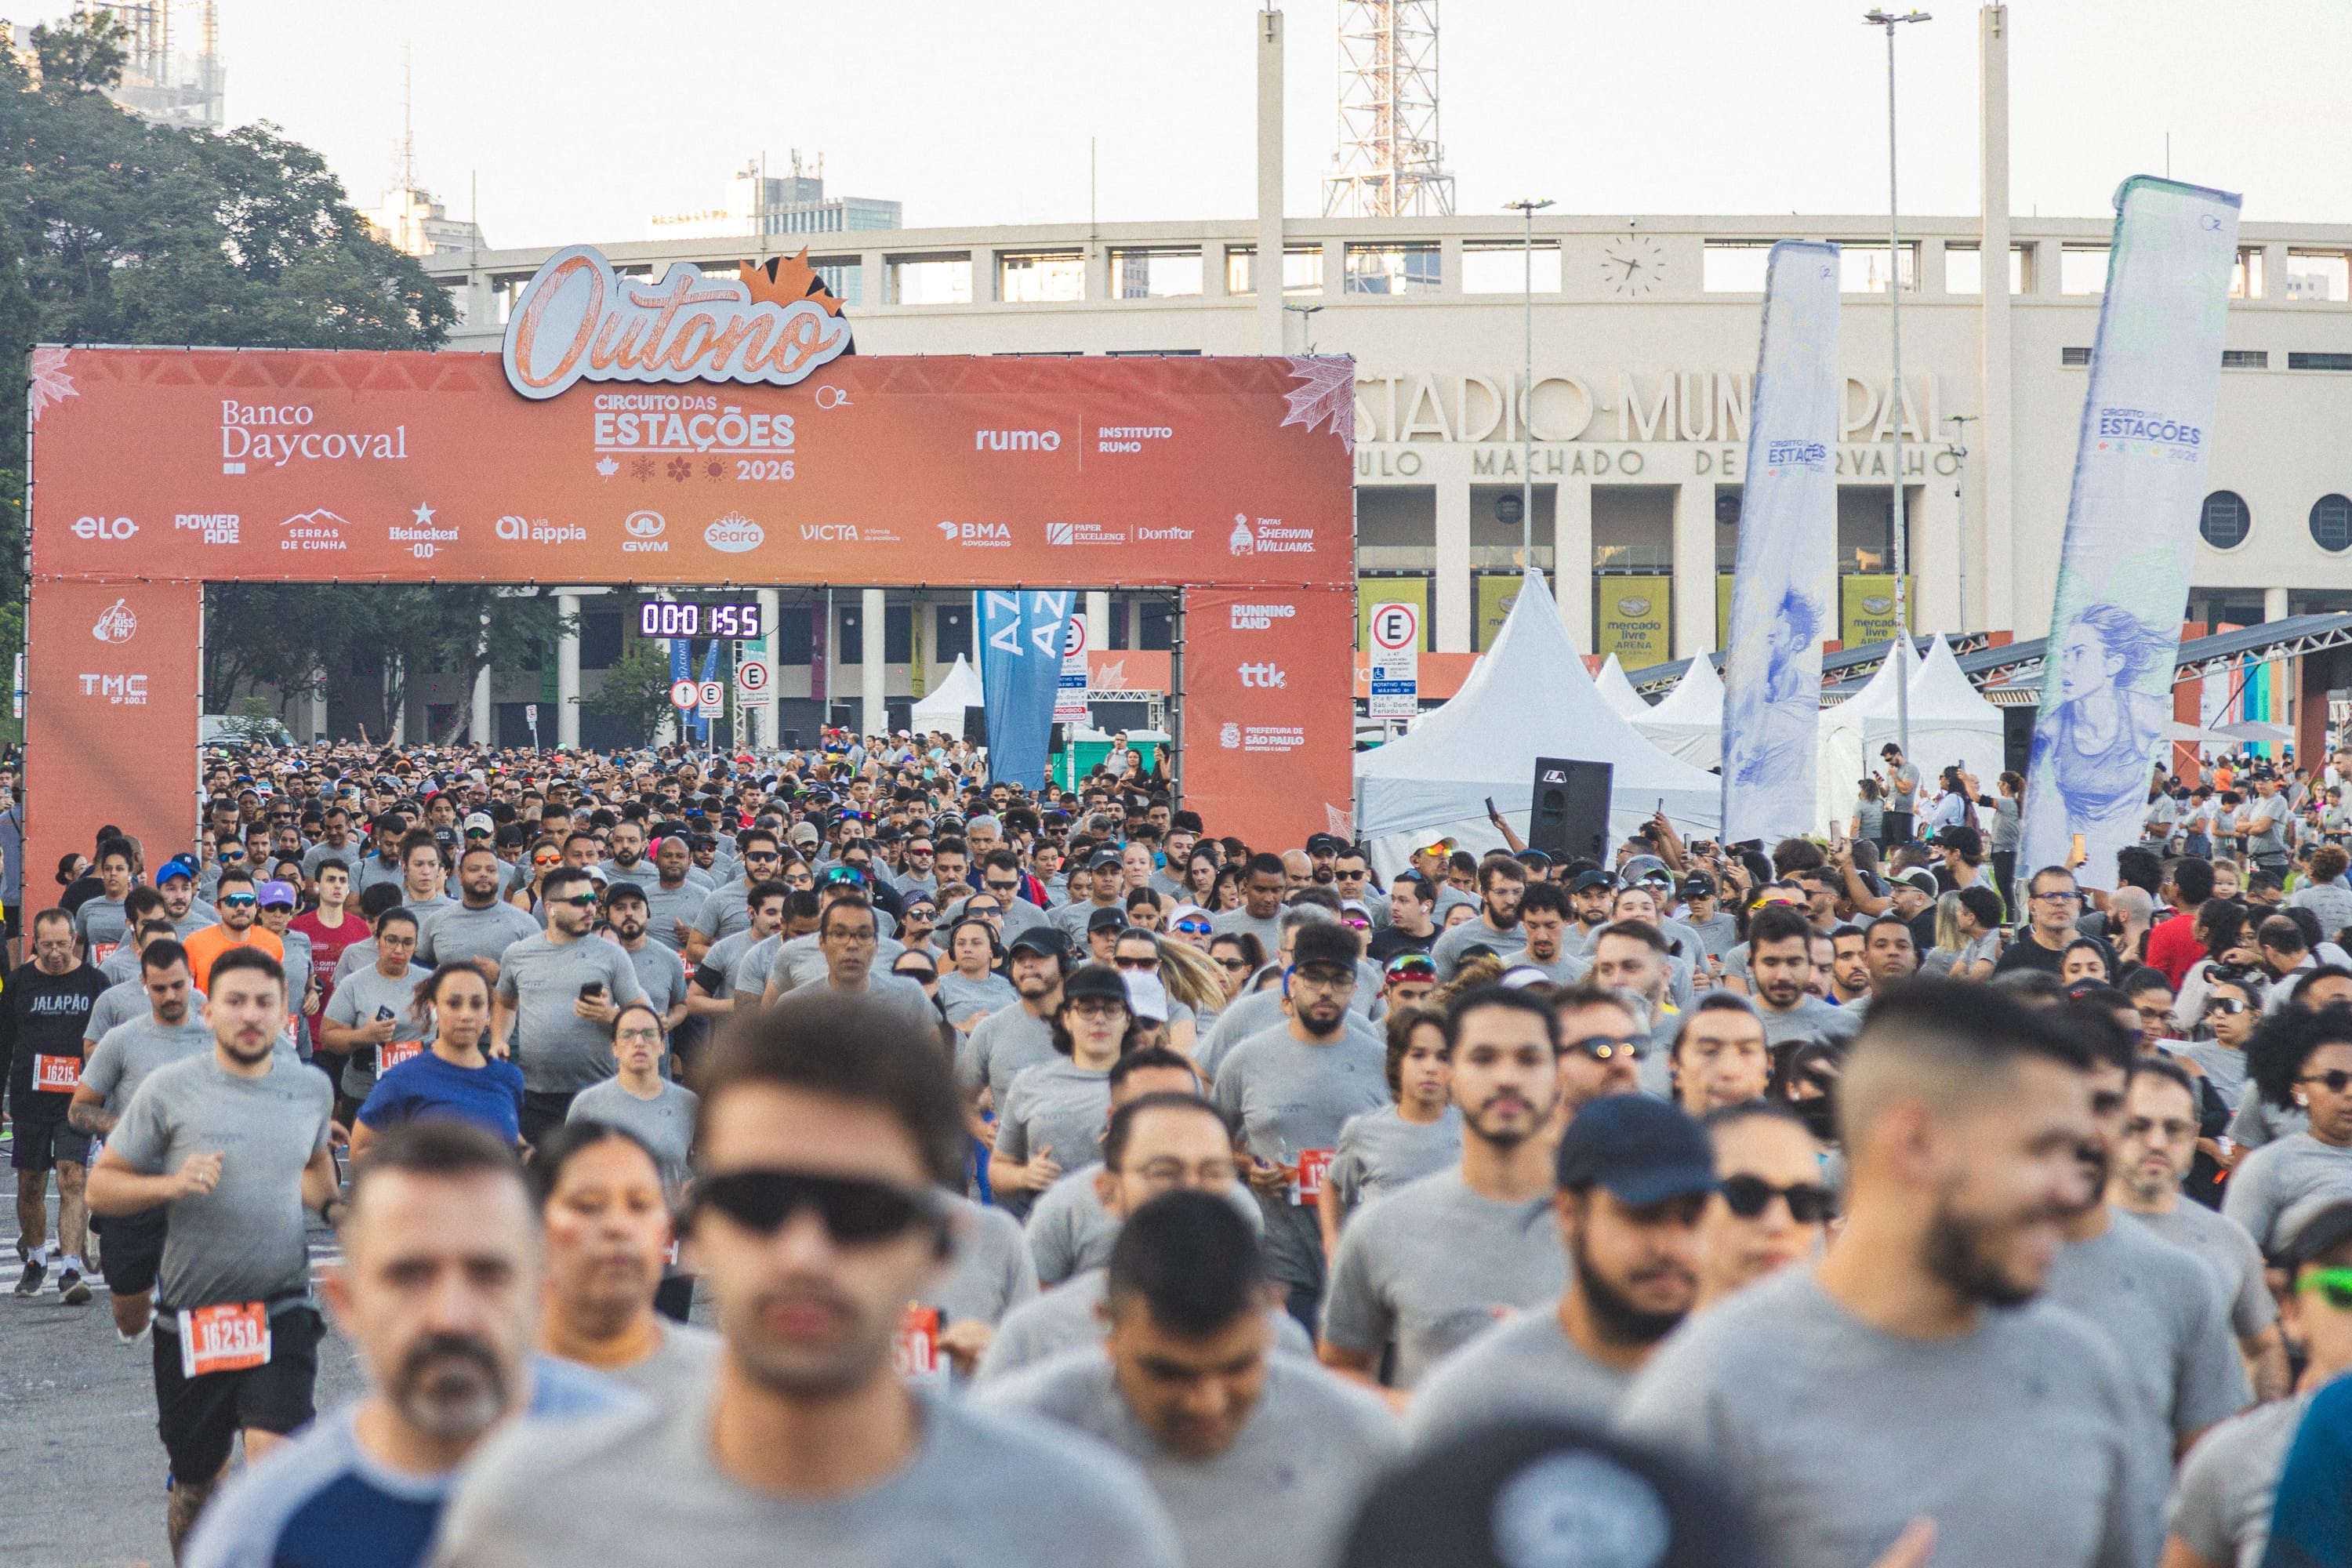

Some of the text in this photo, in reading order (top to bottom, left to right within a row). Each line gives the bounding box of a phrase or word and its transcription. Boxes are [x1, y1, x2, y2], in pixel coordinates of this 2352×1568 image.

[516, 256, 840, 387] Outono
[595, 395, 717, 410] CIRCUITO DAS
[221, 401, 314, 425] Banco
[595, 406, 795, 452] ESTAÇÕES
[1099, 426, 1173, 439] INSTITUTO
[2100, 418, 2201, 445] ESTAÇÕES
[221, 426, 408, 466] Daycoval
[976, 428, 1061, 451] rumo
[1099, 441, 1142, 453] RUMO
[1474, 448, 1643, 476] MACHADO
[1696, 449, 1735, 476] DE
[737, 461, 795, 481] 2026
[176, 514, 239, 529] POWER
[204, 529, 239, 544] ADE
[289, 528, 339, 538] SERRAS
[389, 527, 456, 540] Heineken
[532, 524, 586, 543] appia
[709, 527, 760, 543] Seara
[800, 524, 858, 541] VICTA
[962, 523, 1011, 538] BMA
[1139, 526, 1194, 539] Domtar
[281, 540, 347, 549] DE CUNHA
[623, 542, 668, 552] GWM
[1232, 605, 1295, 617] RUNNING
[114, 619, 134, 628] KISS
[1231, 617, 1271, 630] LAND
[1388, 615, 1402, 639] E
[1608, 621, 1661, 630] mercado
[114, 628, 127, 637] FM
[1622, 630, 1646, 640] livre
[1865, 628, 1888, 637] livre
[749, 669, 758, 684] E
[1240, 662, 1286, 688] ttk
[80, 674, 147, 695] TMC
[708, 688, 714, 699] E
[1245, 734, 1305, 746] SÃO PAULO
[31, 993, 89, 1012] JALAPÃO
[47, 1064, 74, 1081] 16215
